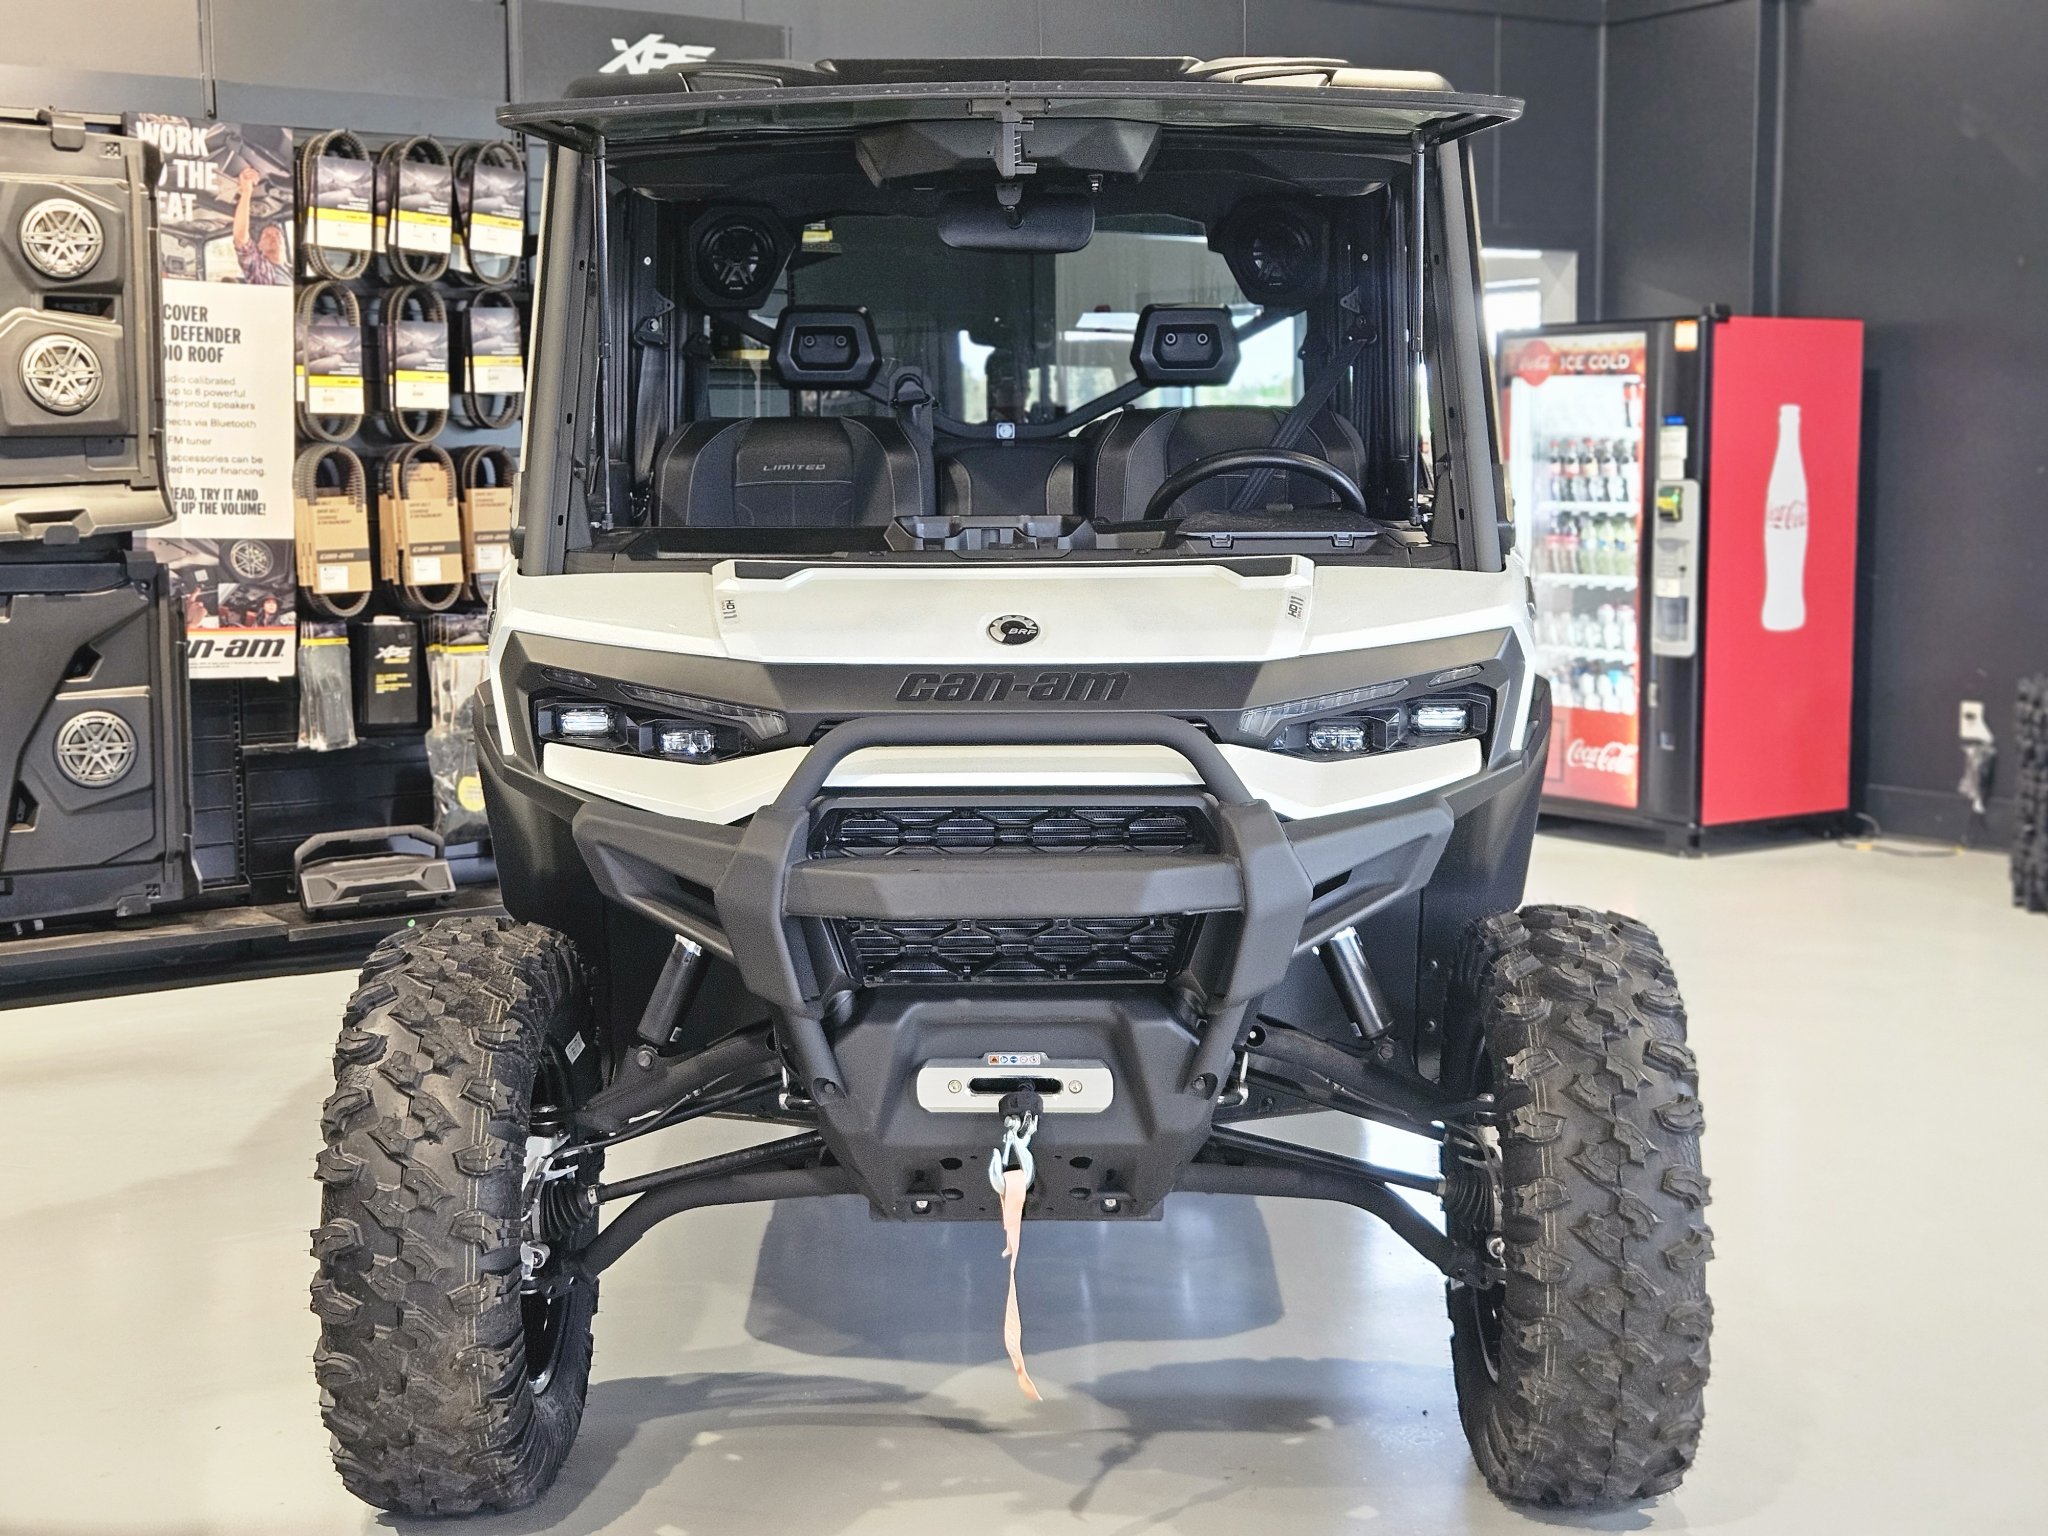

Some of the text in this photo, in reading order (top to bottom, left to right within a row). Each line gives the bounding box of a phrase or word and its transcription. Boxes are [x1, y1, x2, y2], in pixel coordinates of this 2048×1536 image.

[136, 121, 209, 157] WORK
[173, 159, 219, 191] THE
[158, 190, 197, 222] EAT
[163, 303, 208, 322] COVER
[171, 324, 241, 345] DEFENDER
[188, 345, 224, 363] ROOF
[1560, 352, 1631, 371] ICE COLD
[188, 375, 236, 386] calibrated
[168, 387, 181, 396] up
[183, 387, 193, 396] to
[203, 388, 247, 399] powerful
[212, 401, 256, 411] speakers
[195, 419, 208, 427] via
[210, 418, 257, 429] Bluetooth
[167, 435, 212, 446] FM tuner
[171, 454, 230, 463] accessories
[231, 456, 249, 464] can
[251, 455, 264, 464] be
[185, 465, 195, 474] in
[196, 467, 219, 476] your
[763, 464, 826, 472] LIMITED
[200, 488, 221, 500] TRY
[223, 488, 234, 501] IT
[236, 488, 259, 501] AND
[181, 501, 197, 514] UP
[199, 502, 218, 515] THE
[221, 502, 267, 516] VOLUME!
[1008, 627, 1037, 635] BRP
[187, 638, 286, 659] n-am
[895, 671, 1131, 701] can-am
